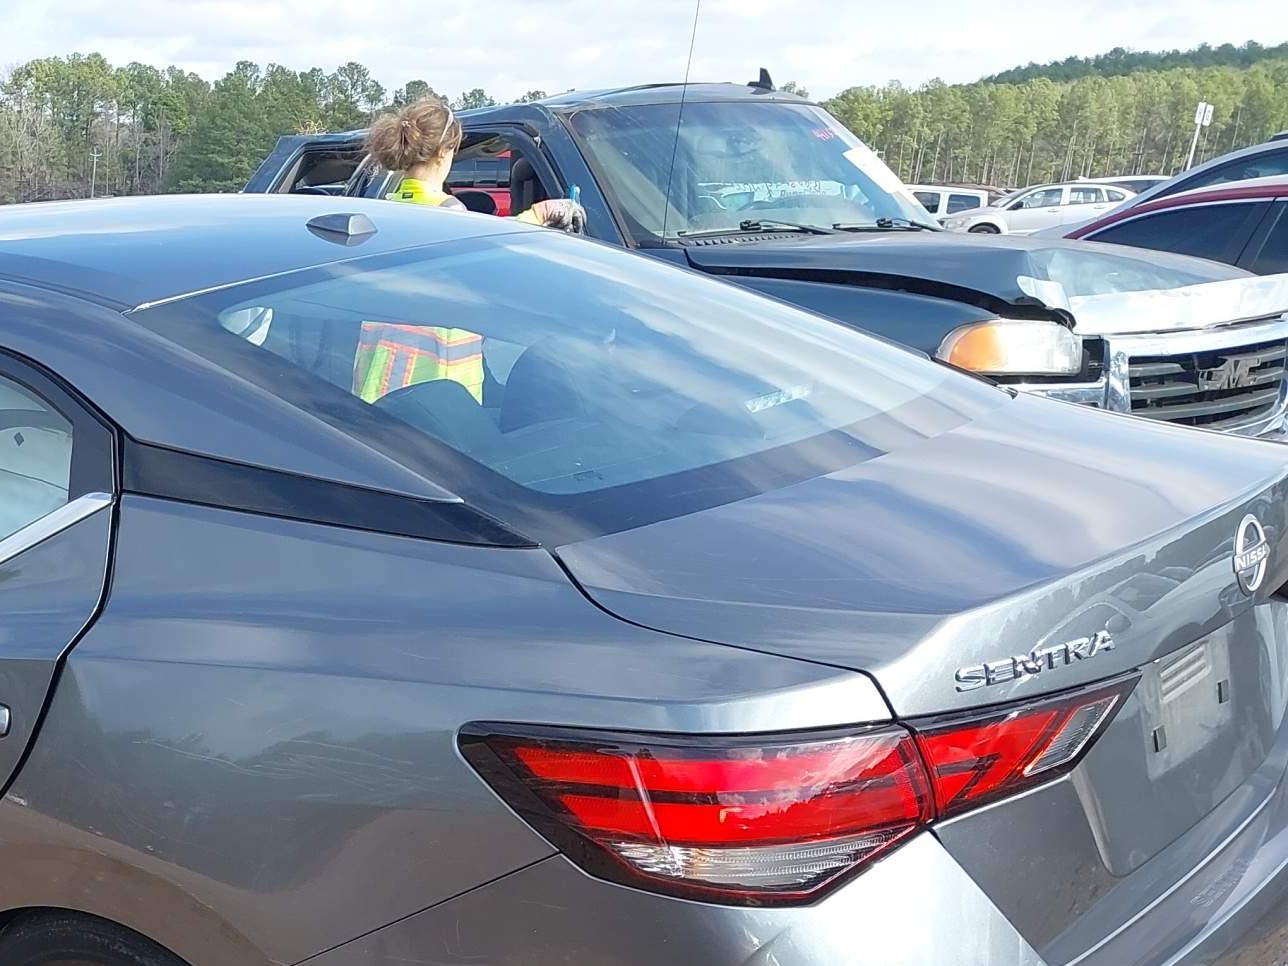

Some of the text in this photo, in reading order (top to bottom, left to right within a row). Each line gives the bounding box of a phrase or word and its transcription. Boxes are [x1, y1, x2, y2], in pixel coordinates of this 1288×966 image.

[1198, 358, 1261, 392] GMC
[1235, 544, 1267, 572] NISS
[955, 630, 1116, 693] SENTRA
